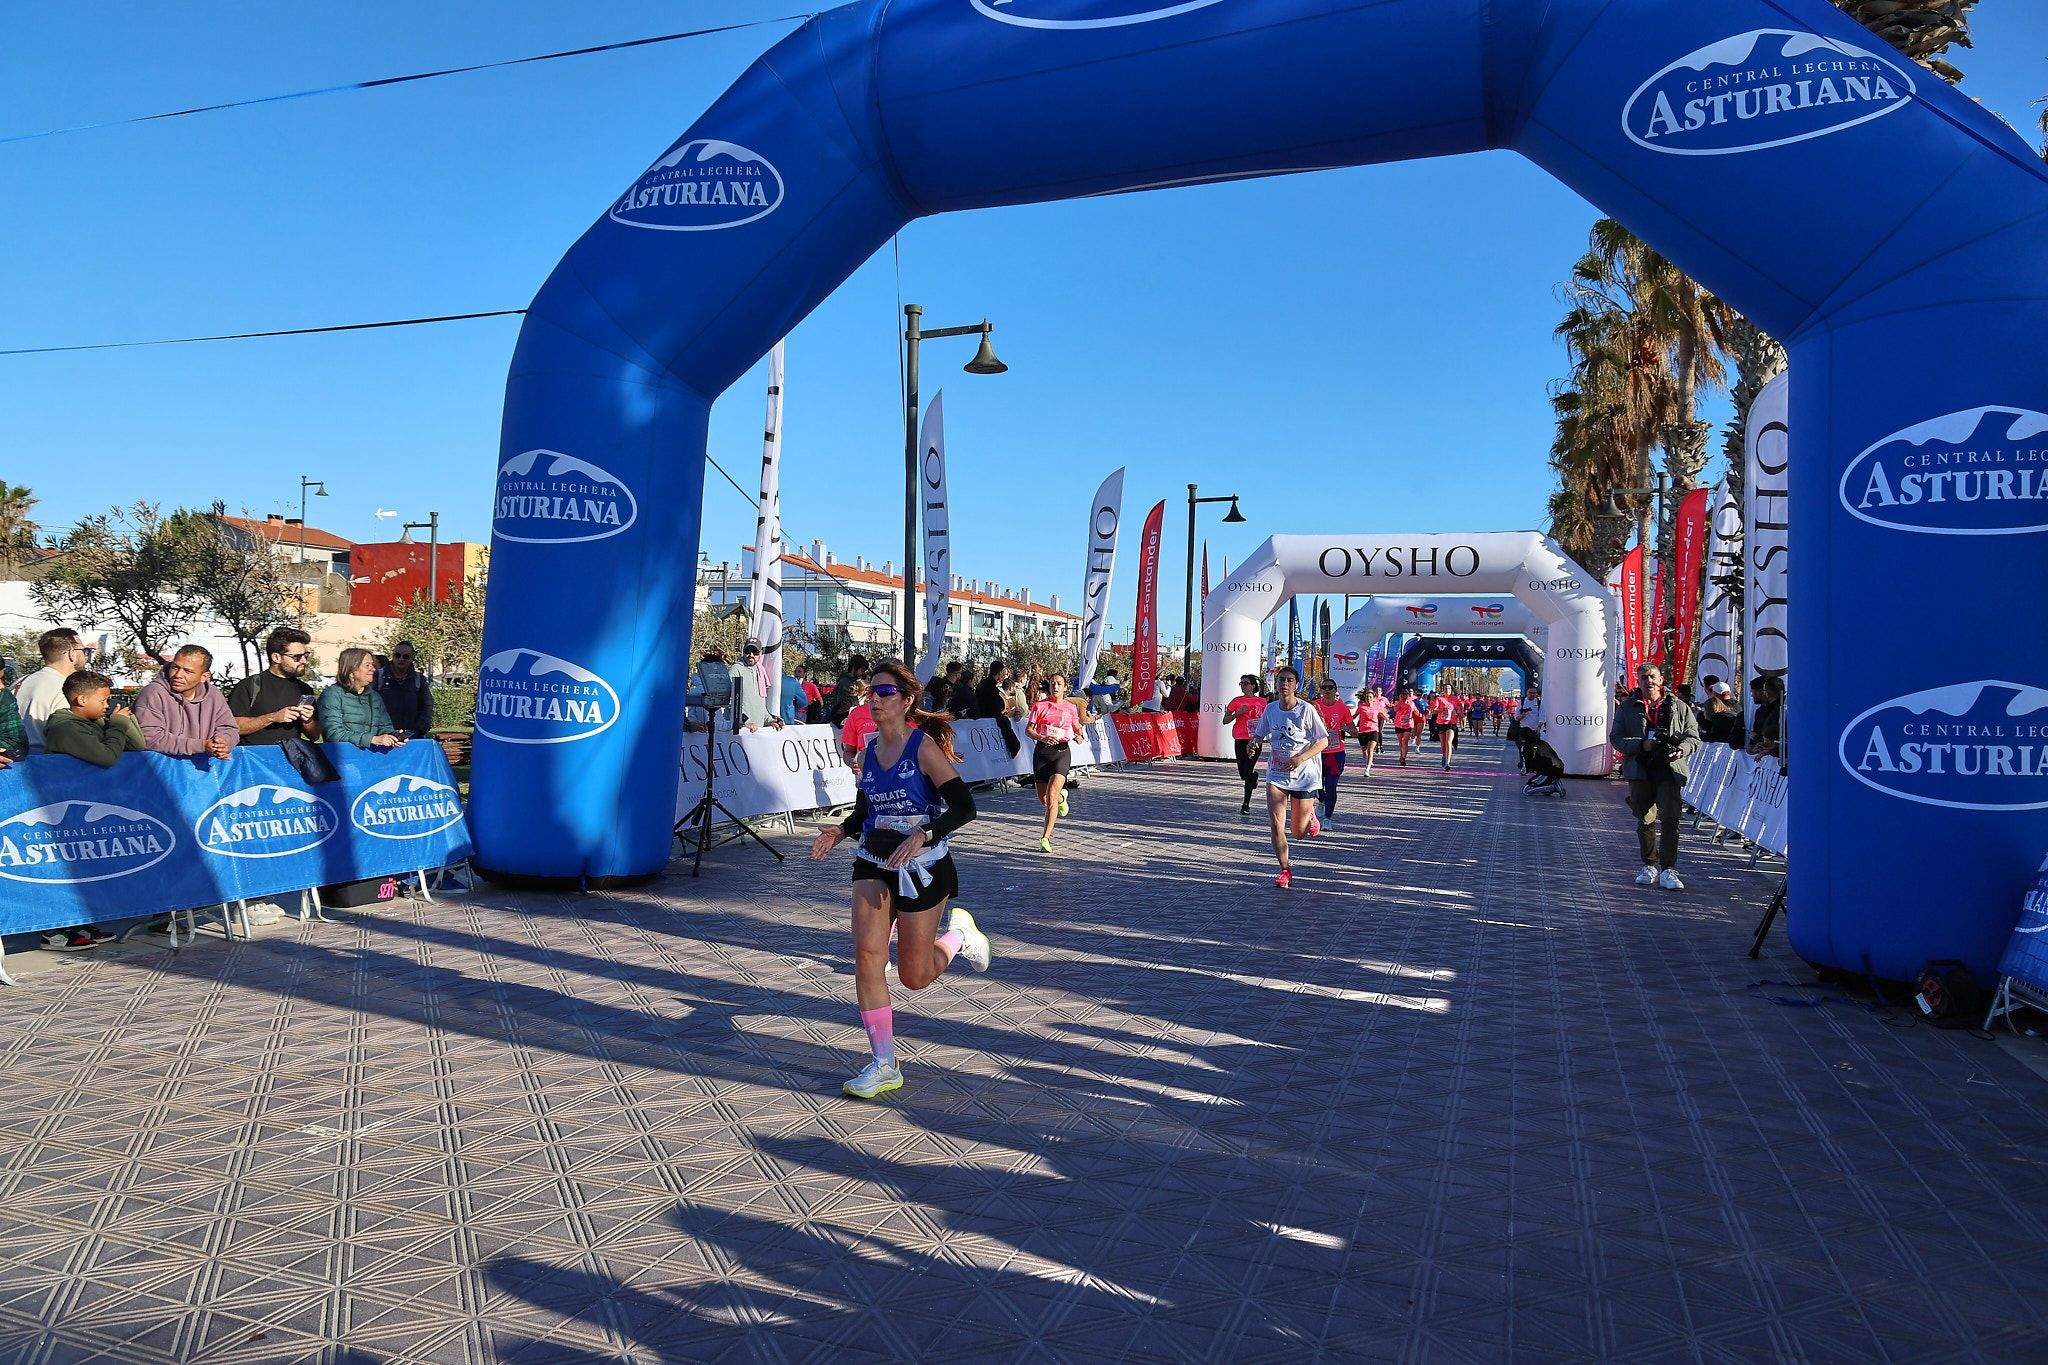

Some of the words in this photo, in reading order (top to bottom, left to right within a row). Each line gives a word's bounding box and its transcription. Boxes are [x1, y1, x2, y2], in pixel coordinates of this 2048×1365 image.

[1687, 66, 1781, 93] CENTRAL
[1792, 60, 1881, 75] LECHERA
[1644, 75, 1899, 139] ASTURIANA
[645, 169, 694, 185] CENTRAL
[700, 166, 762, 176] LECHERA
[615, 180, 769, 214] ASTURIANA
[1904, 450, 2004, 467] CENTRAL
[503, 482, 546, 491] CENTRAL
[552, 482, 617, 497] LECHERA
[1318, 545, 1481, 578] OYSHO
[1228, 582, 1273, 593] OYSHO
[1529, 579, 1581, 591] OYSHO
[1206, 642, 1247, 653] OYSHO
[1436, 644, 1506, 652] VOLVO
[1556, 648, 1606, 659] OYSHO
[1138, 639, 1151, 691] Sports
[485, 678, 528, 691] CENTRAL
[534, 683, 599, 696] LECHERA
[1203, 703, 1227, 713] OYS
[1555, 714, 1604, 727] OYSHO
[1903, 723, 2004, 737] CENTRAL
[971, 727, 1005, 753] OYSH
[782, 738, 844, 773] OYSH
[868, 788, 907, 802] POBLATS
[229, 809, 276, 820] CENTRAL
[363, 800, 460, 827] ASTURIANA
[23, 828, 87, 841] CENTRAL
[93, 823, 152, 835] LECHERA
[206, 814, 331, 846] ASTURIANA
